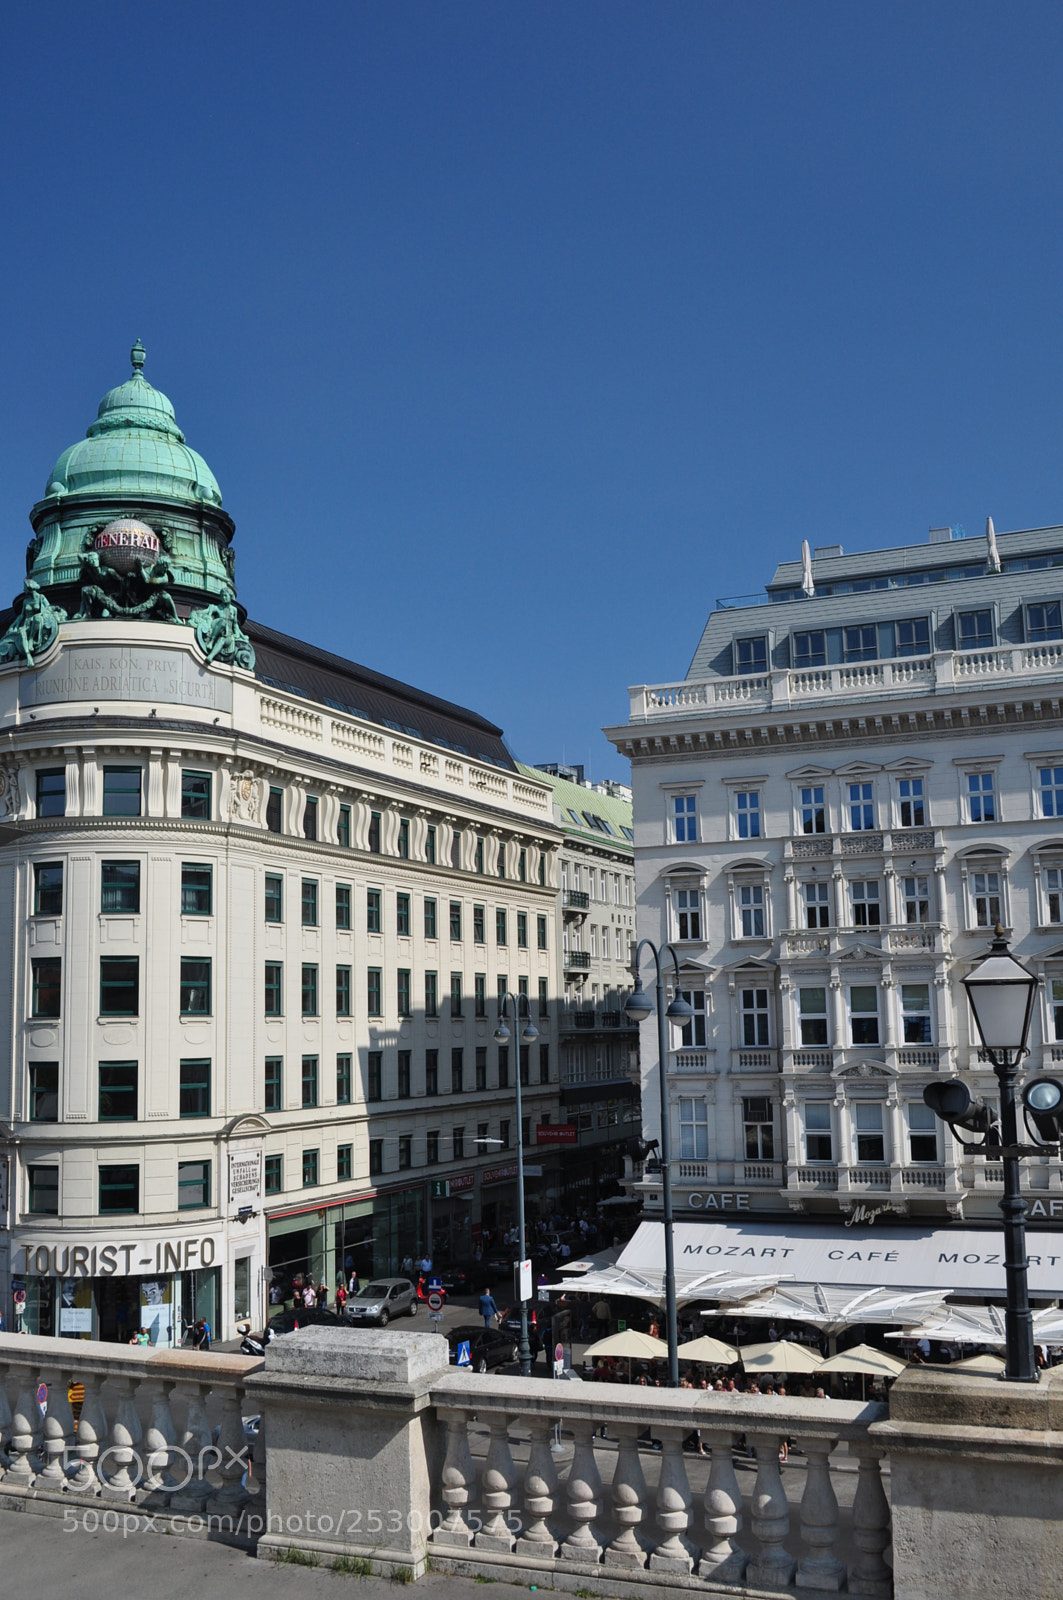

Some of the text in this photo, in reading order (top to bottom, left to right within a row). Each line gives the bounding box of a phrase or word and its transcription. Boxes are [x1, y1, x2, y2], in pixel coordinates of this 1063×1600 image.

[95, 532, 159, 552] GENERALI
[74, 658, 104, 670] KAIS.
[147, 660, 177, 673] PRIV.
[611, 913, 632, 926] HOTE
[688, 1193, 750, 1210] CAFE
[1023, 1199, 1063, 1216] AF
[844, 1199, 892, 1227] Mozart
[682, 1244, 1061, 1266] MOZART CAFÉ MOZRT
